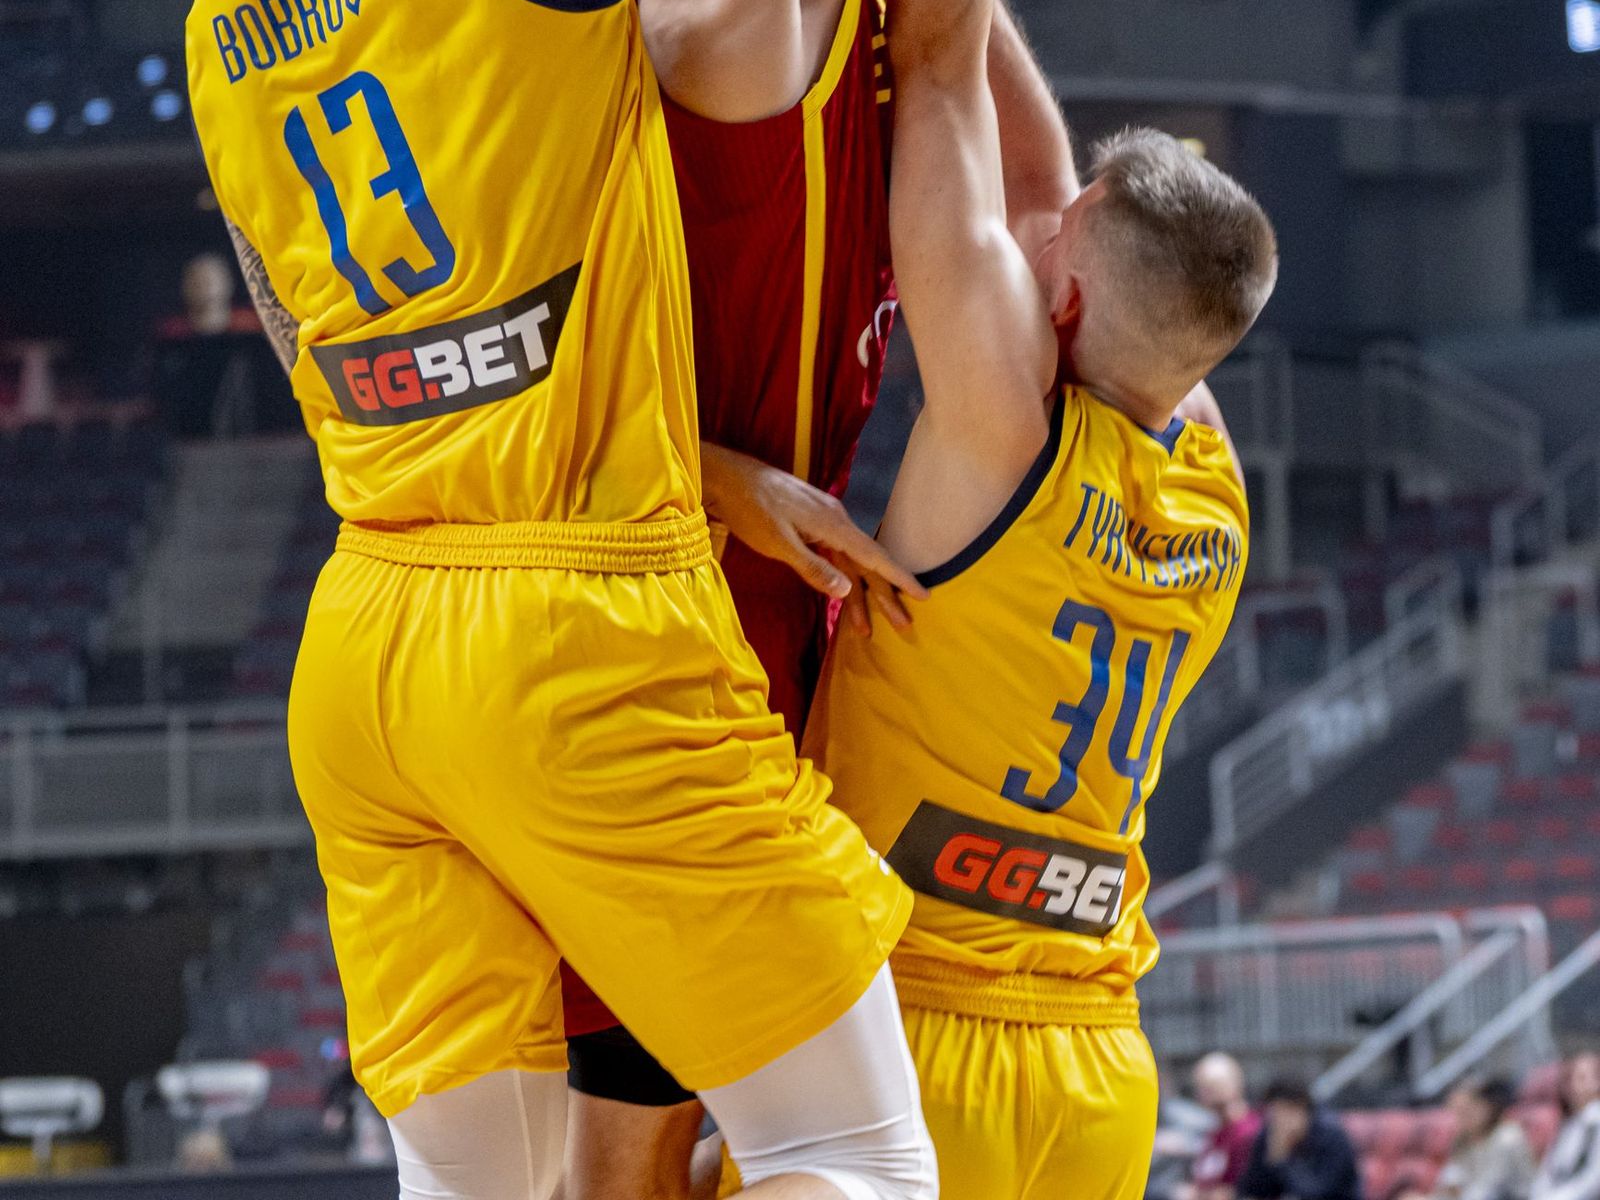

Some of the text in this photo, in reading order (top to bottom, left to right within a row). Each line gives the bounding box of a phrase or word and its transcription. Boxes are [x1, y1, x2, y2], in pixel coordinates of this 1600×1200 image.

[284, 71, 455, 316] 13
[342, 302, 551, 411] GG.BET
[1001, 599, 1190, 835] 34
